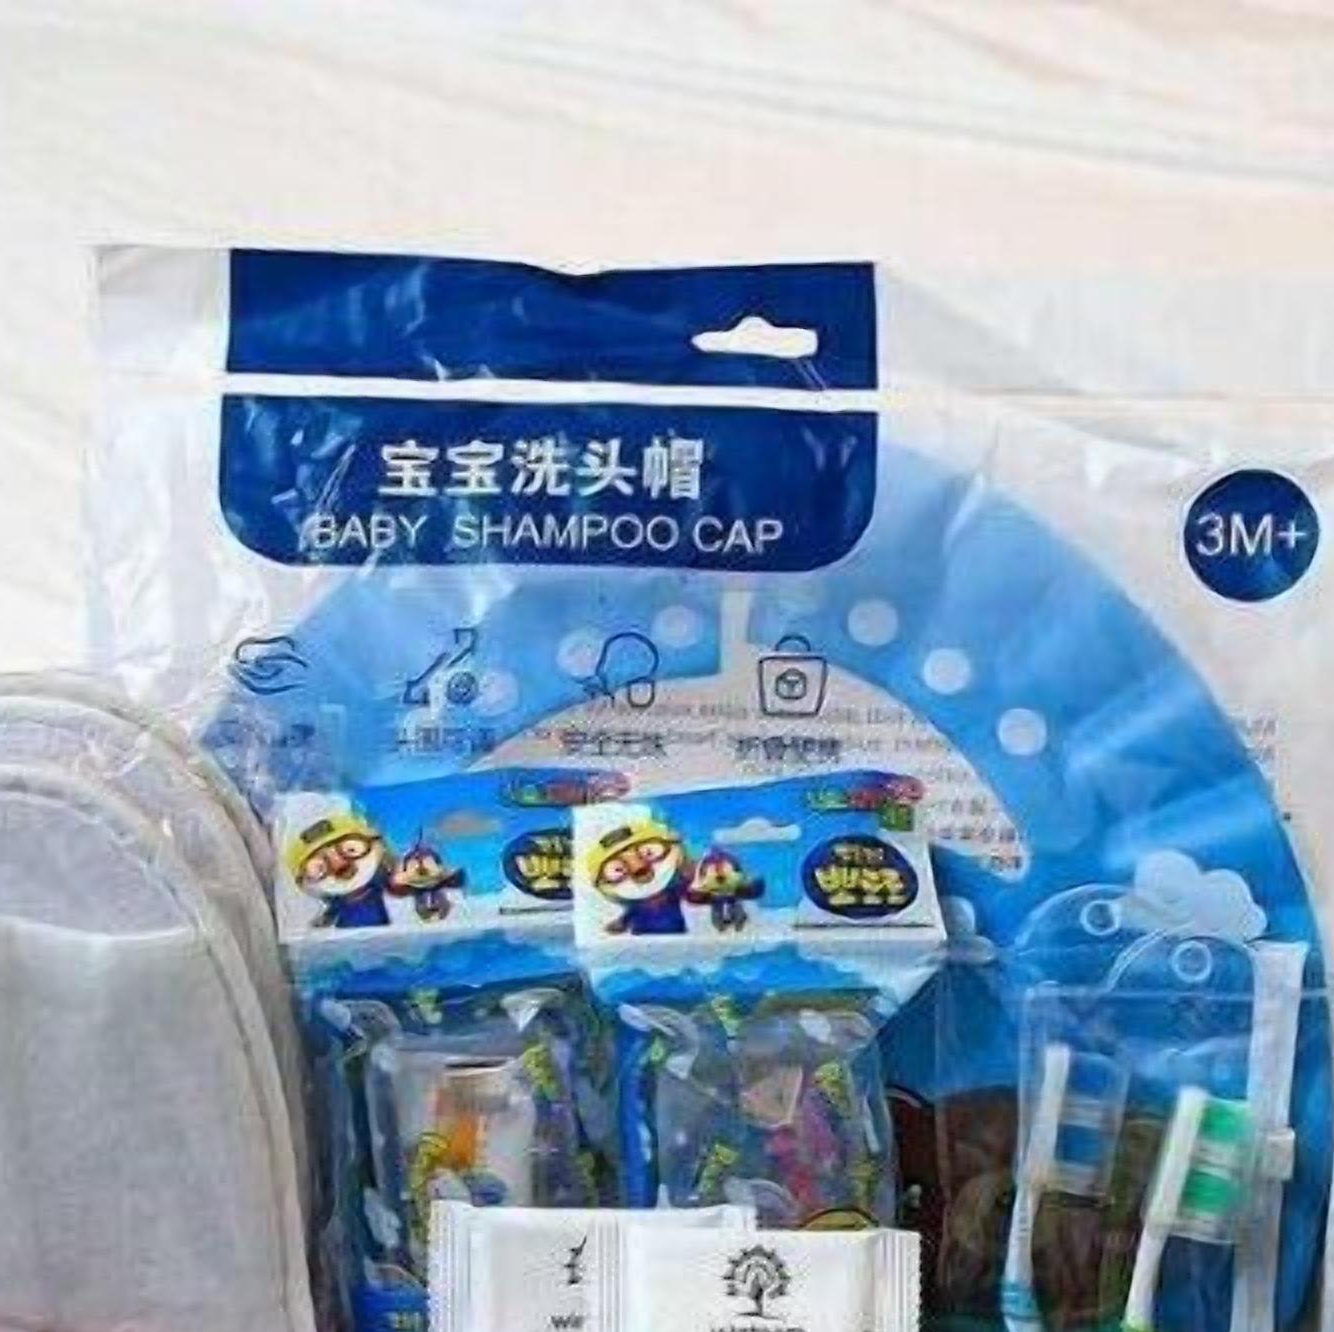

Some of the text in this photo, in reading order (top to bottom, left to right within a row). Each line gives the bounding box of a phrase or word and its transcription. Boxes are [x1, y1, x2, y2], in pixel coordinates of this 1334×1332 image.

[380, 438, 705, 500] 宝宝洗头帽
[313, 513, 784, 555] BABY SHAMPOO CAP
[1196, 510, 1309, 557] 3M+
